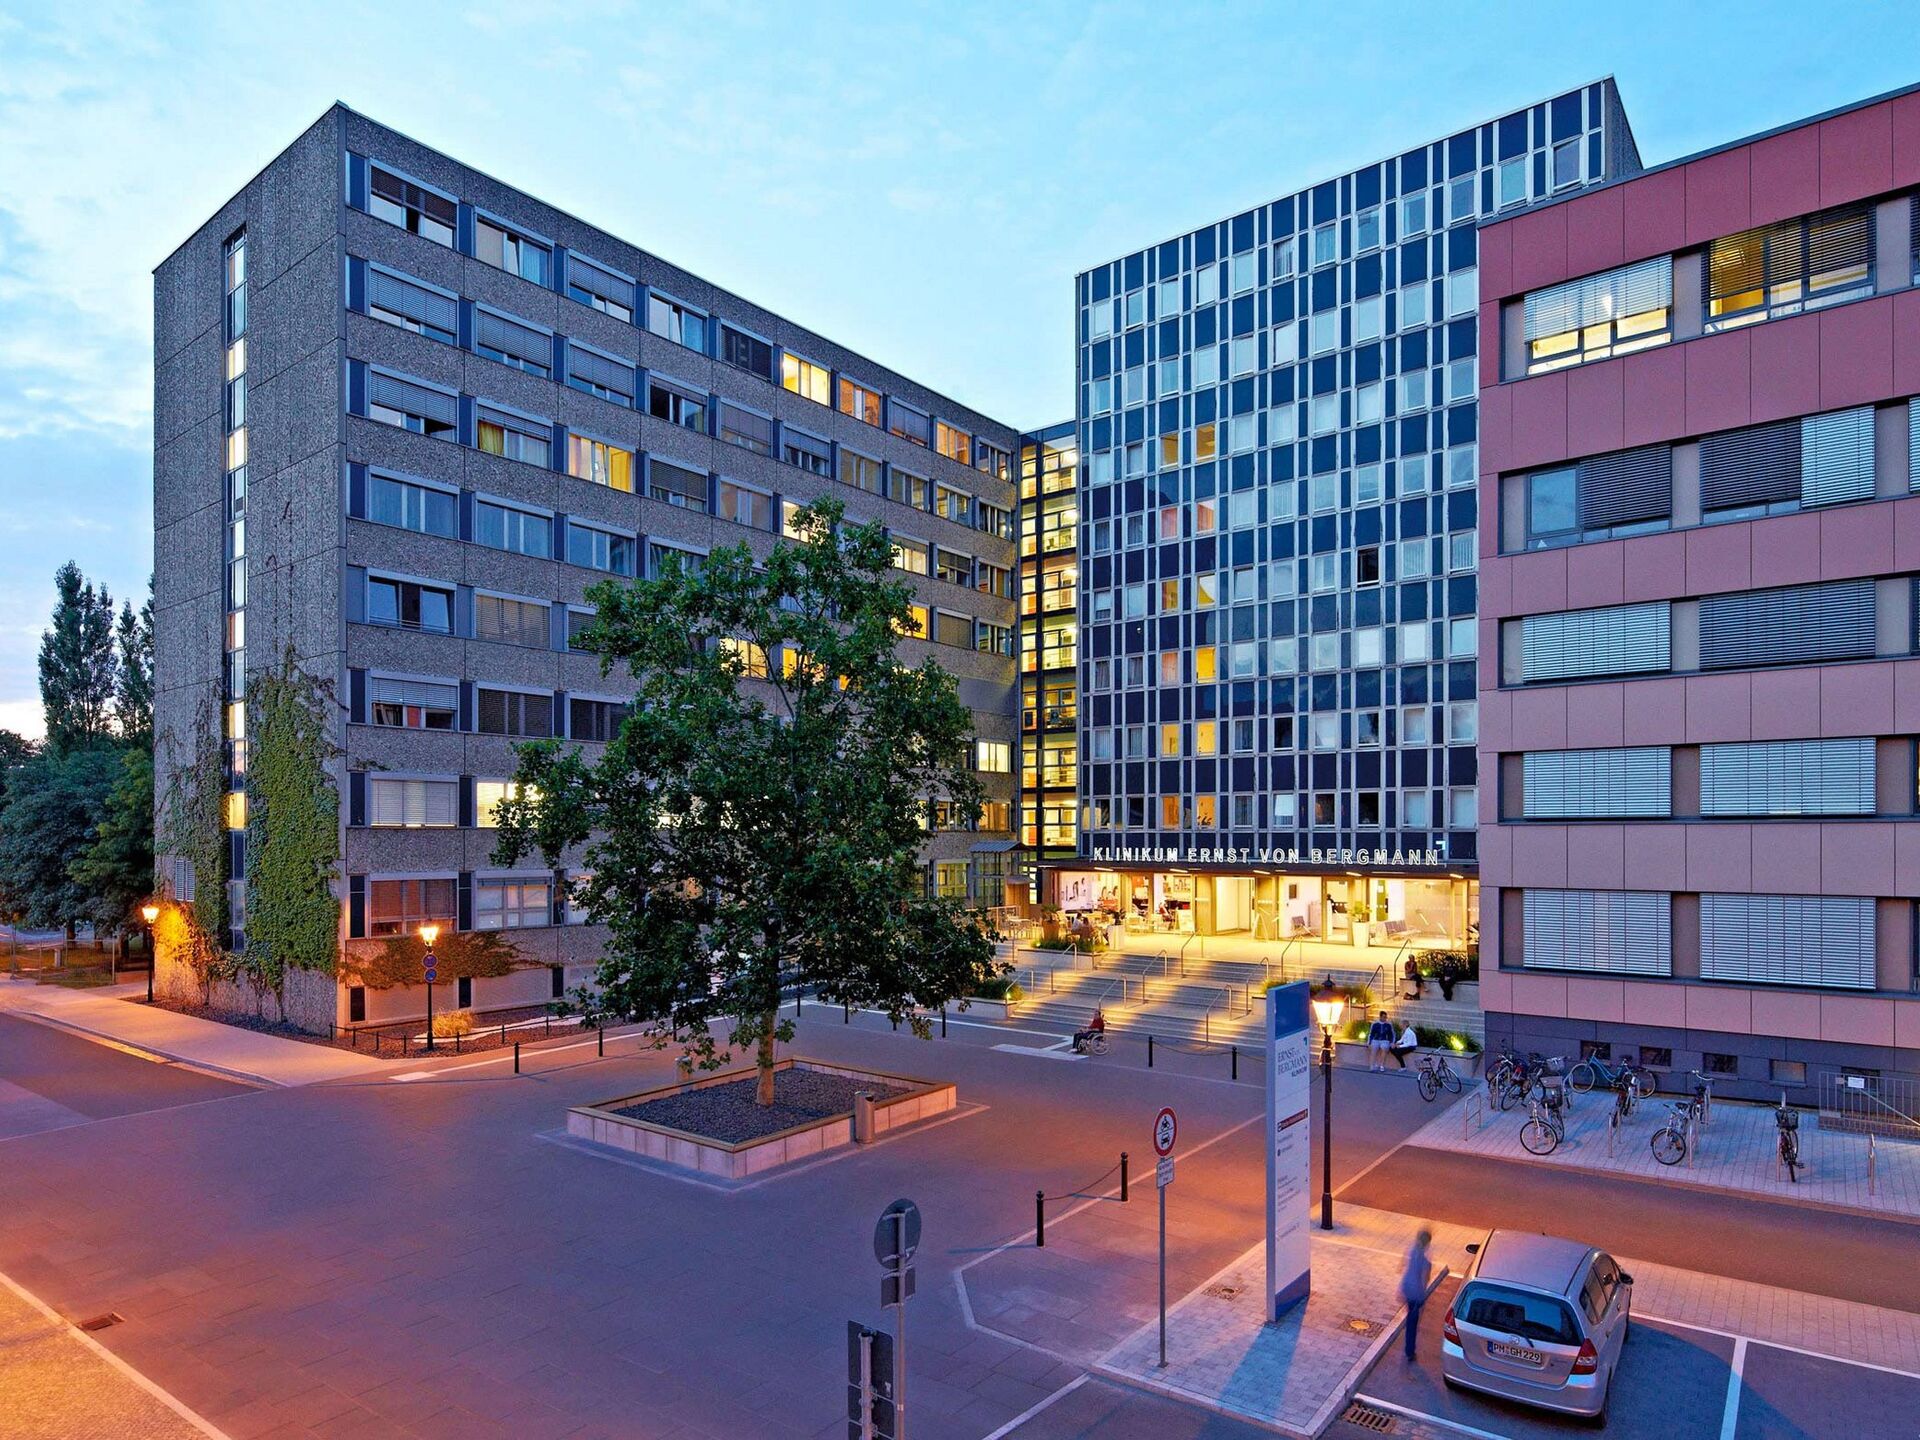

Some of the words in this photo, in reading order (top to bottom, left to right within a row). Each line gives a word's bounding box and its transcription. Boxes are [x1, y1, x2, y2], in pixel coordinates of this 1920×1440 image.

[1093, 847, 1178, 862] KLINIKUM
[1187, 848, 1250, 864] ERNST
[1259, 848, 1300, 864] VON
[1311, 849, 1438, 866] BERGMANN
